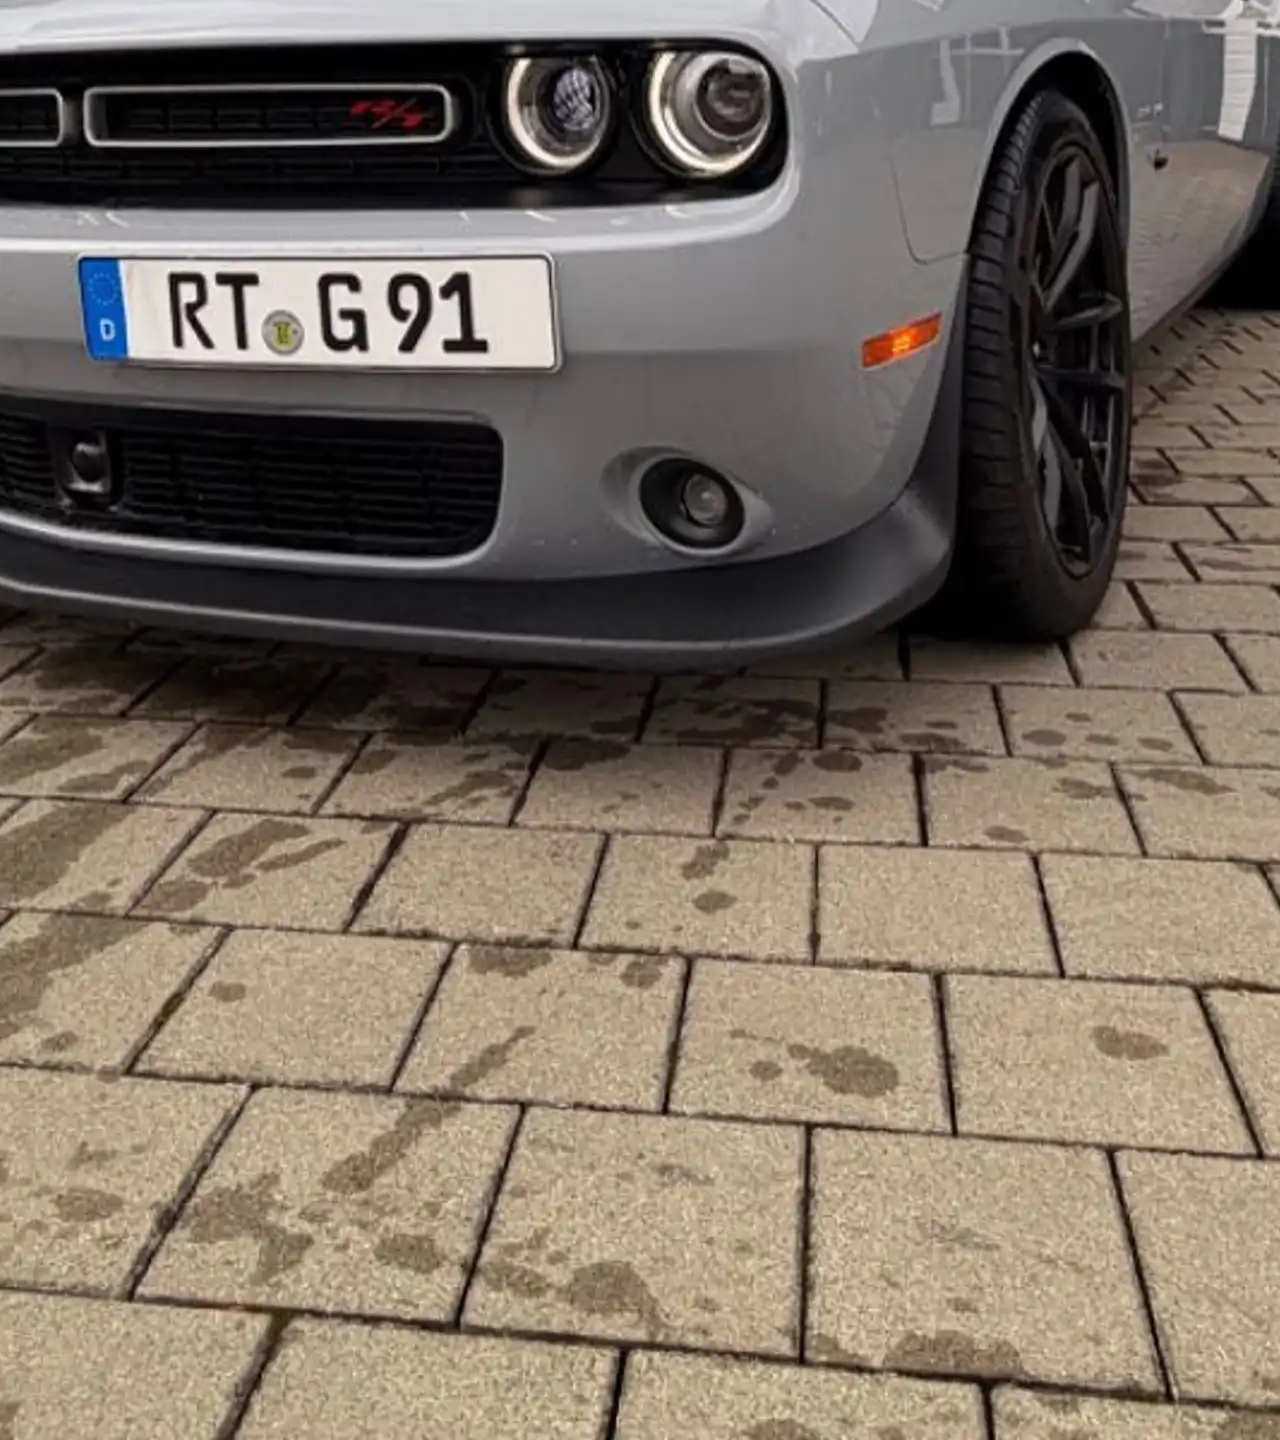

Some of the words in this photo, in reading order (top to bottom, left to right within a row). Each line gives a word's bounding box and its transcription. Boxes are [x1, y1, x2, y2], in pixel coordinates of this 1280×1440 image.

[99, 318, 116, 342] D
[167, 271, 260, 351] RT
[318, 273, 369, 352] G
[387, 272, 490, 353] 91
